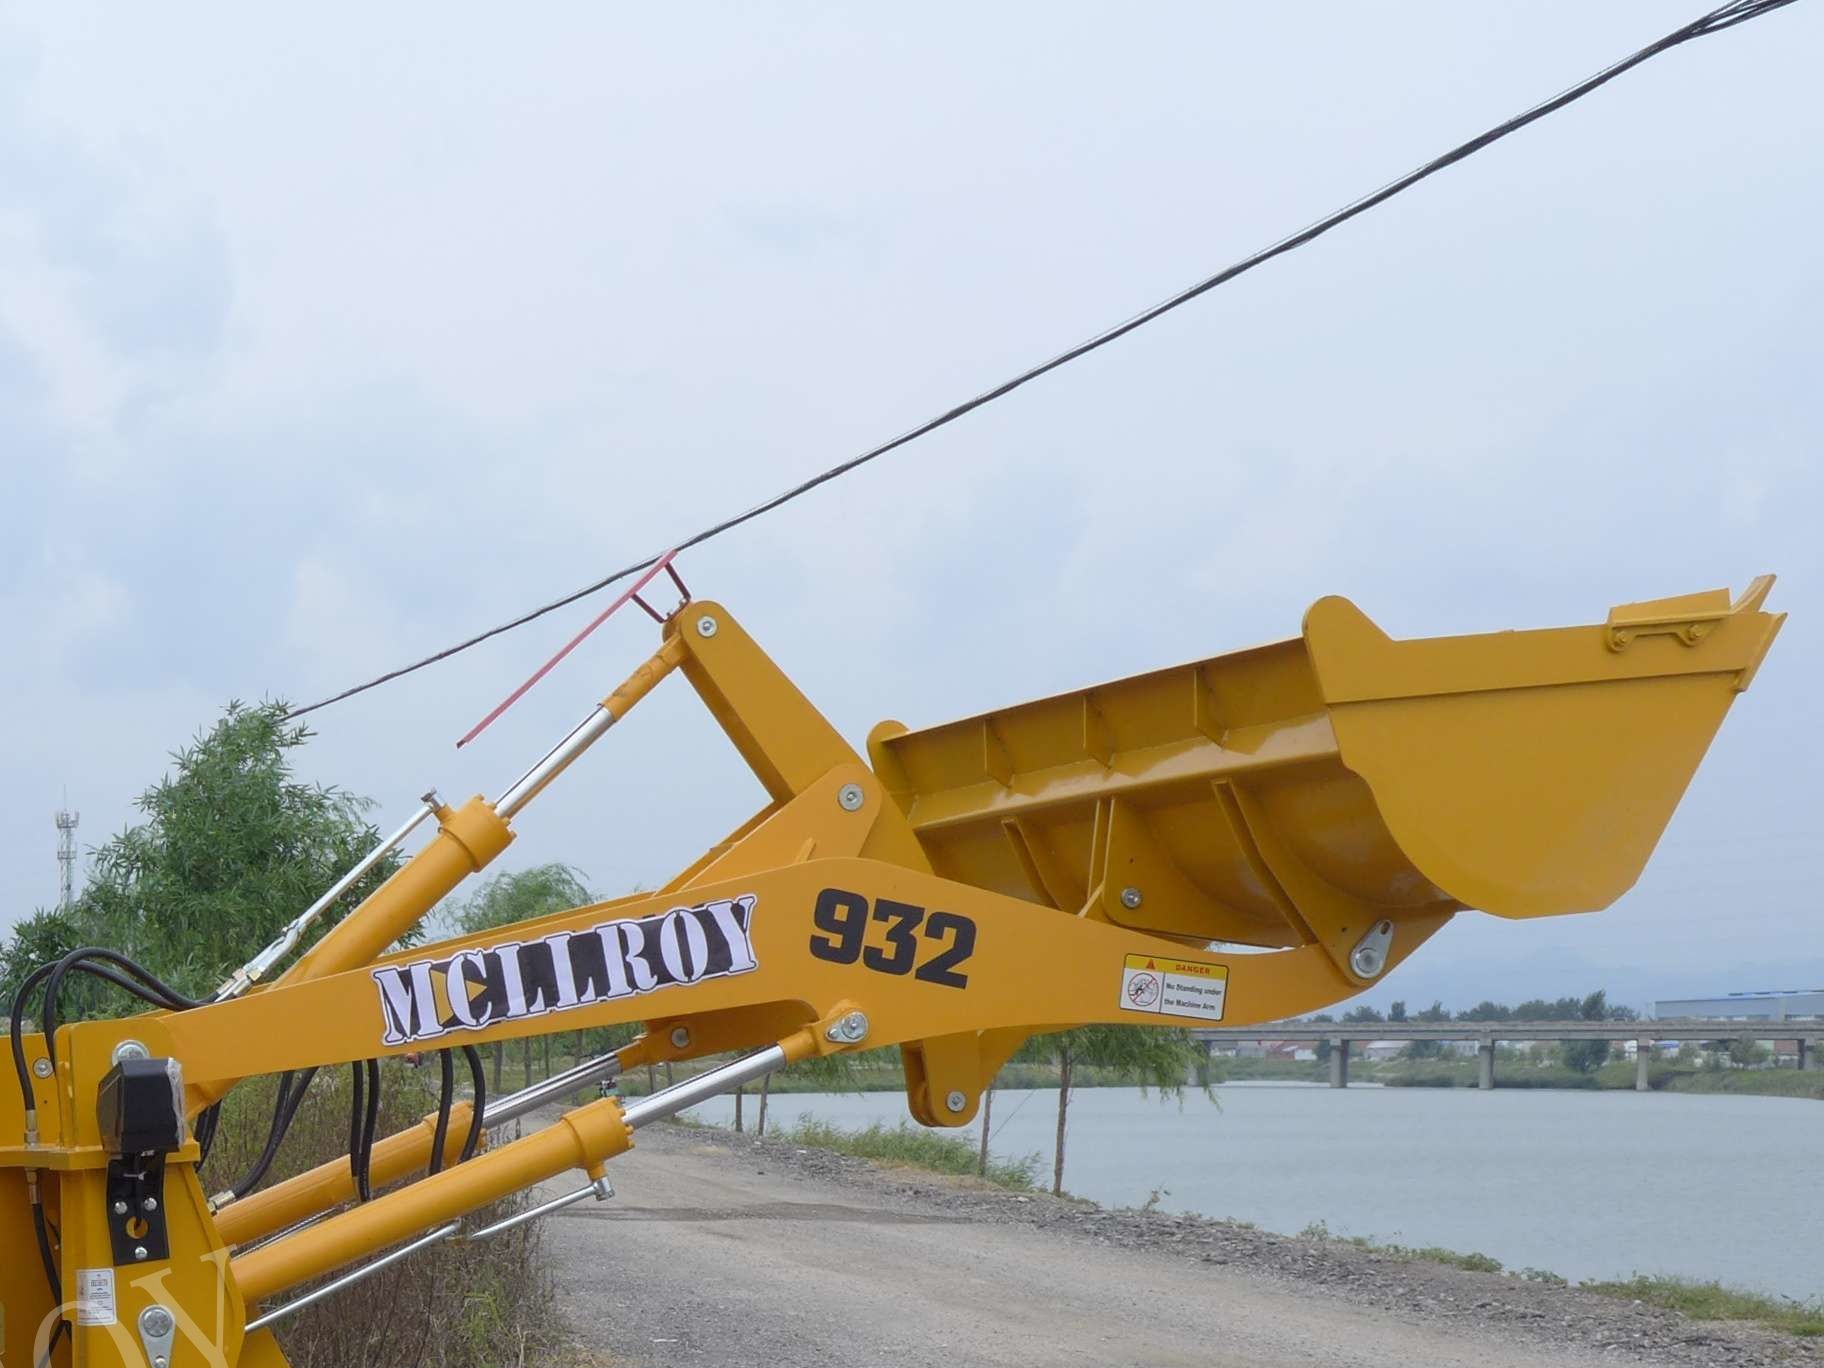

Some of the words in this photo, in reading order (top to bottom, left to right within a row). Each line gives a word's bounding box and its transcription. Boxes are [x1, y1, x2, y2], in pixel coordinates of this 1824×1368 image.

[373, 895, 758, 1045] MCLLROY
[809, 888, 976, 989] 932
[1175, 964, 1211, 975] DANGER
